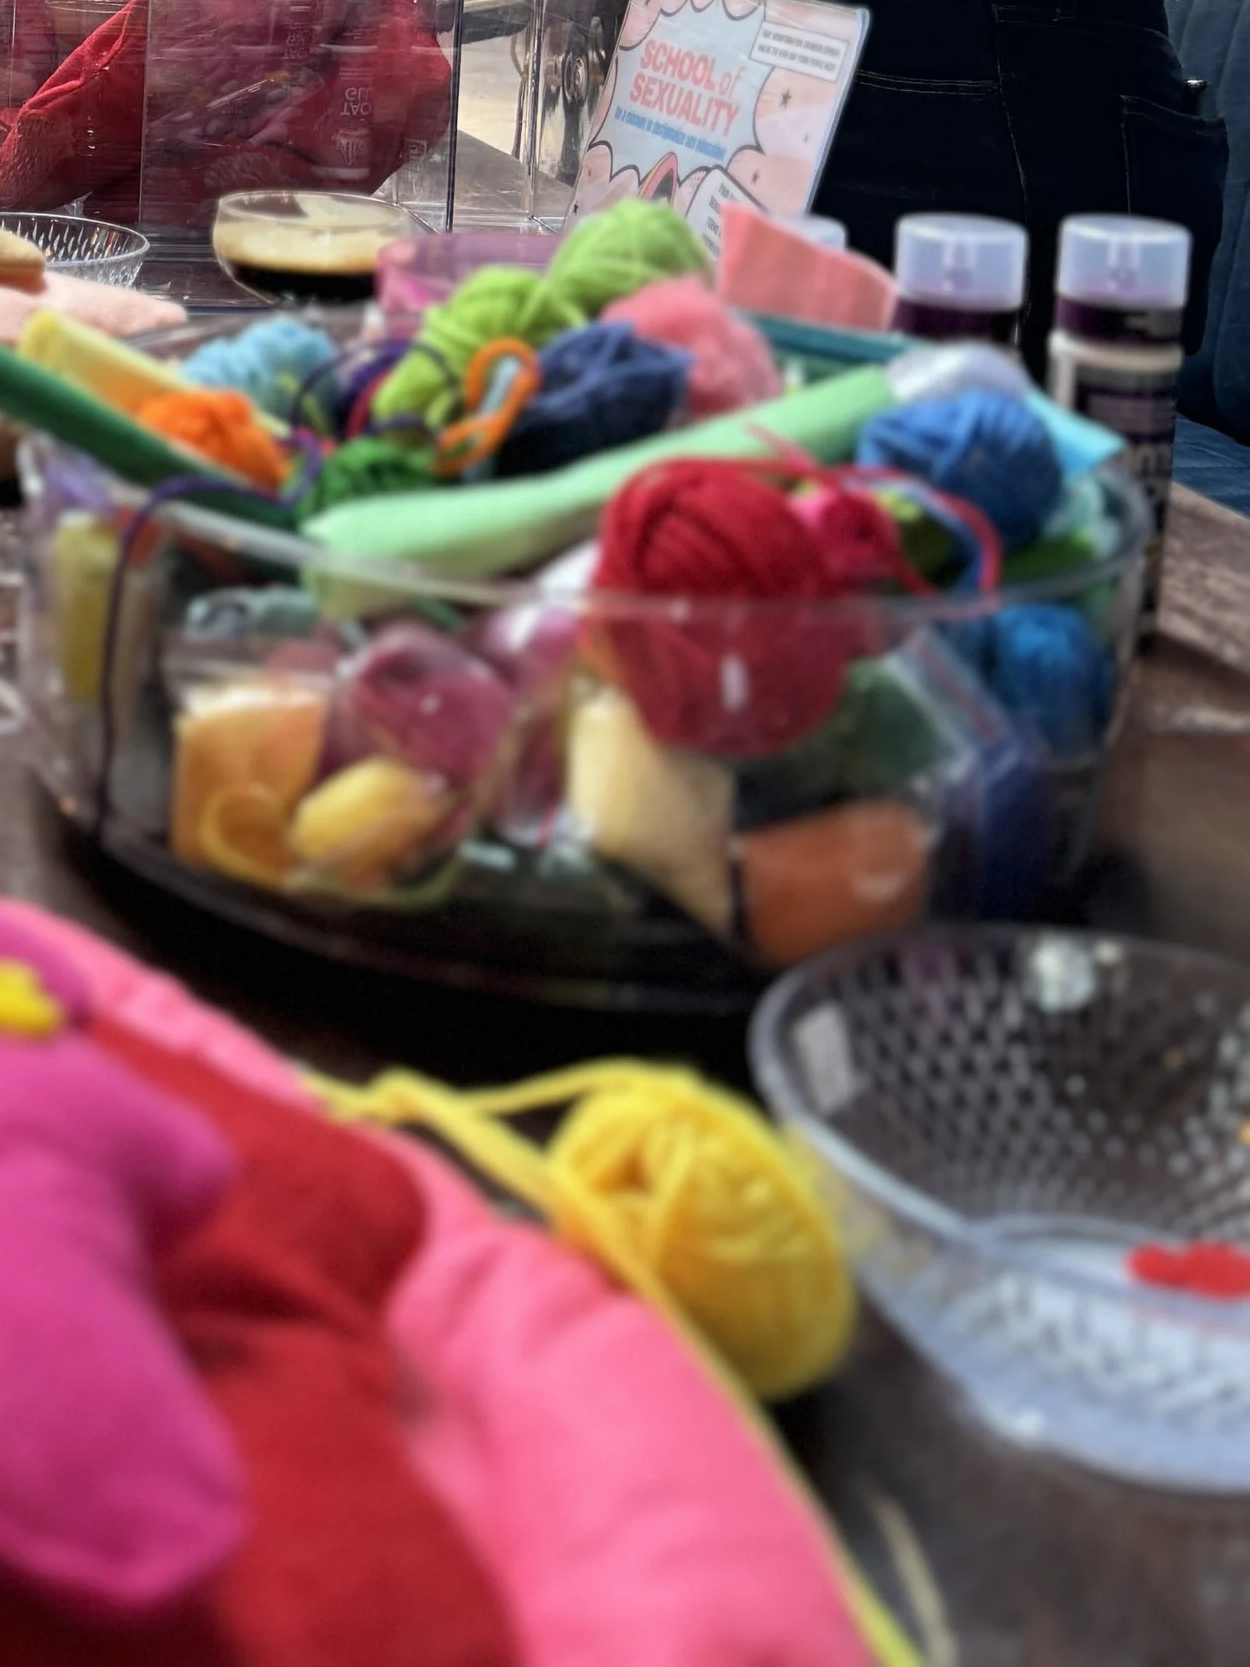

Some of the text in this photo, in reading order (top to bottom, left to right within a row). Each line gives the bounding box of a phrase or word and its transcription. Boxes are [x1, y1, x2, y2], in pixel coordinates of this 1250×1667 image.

[640, 39, 746, 98] SCHOOL of
[630, 72, 740, 137] SEXUALITY
